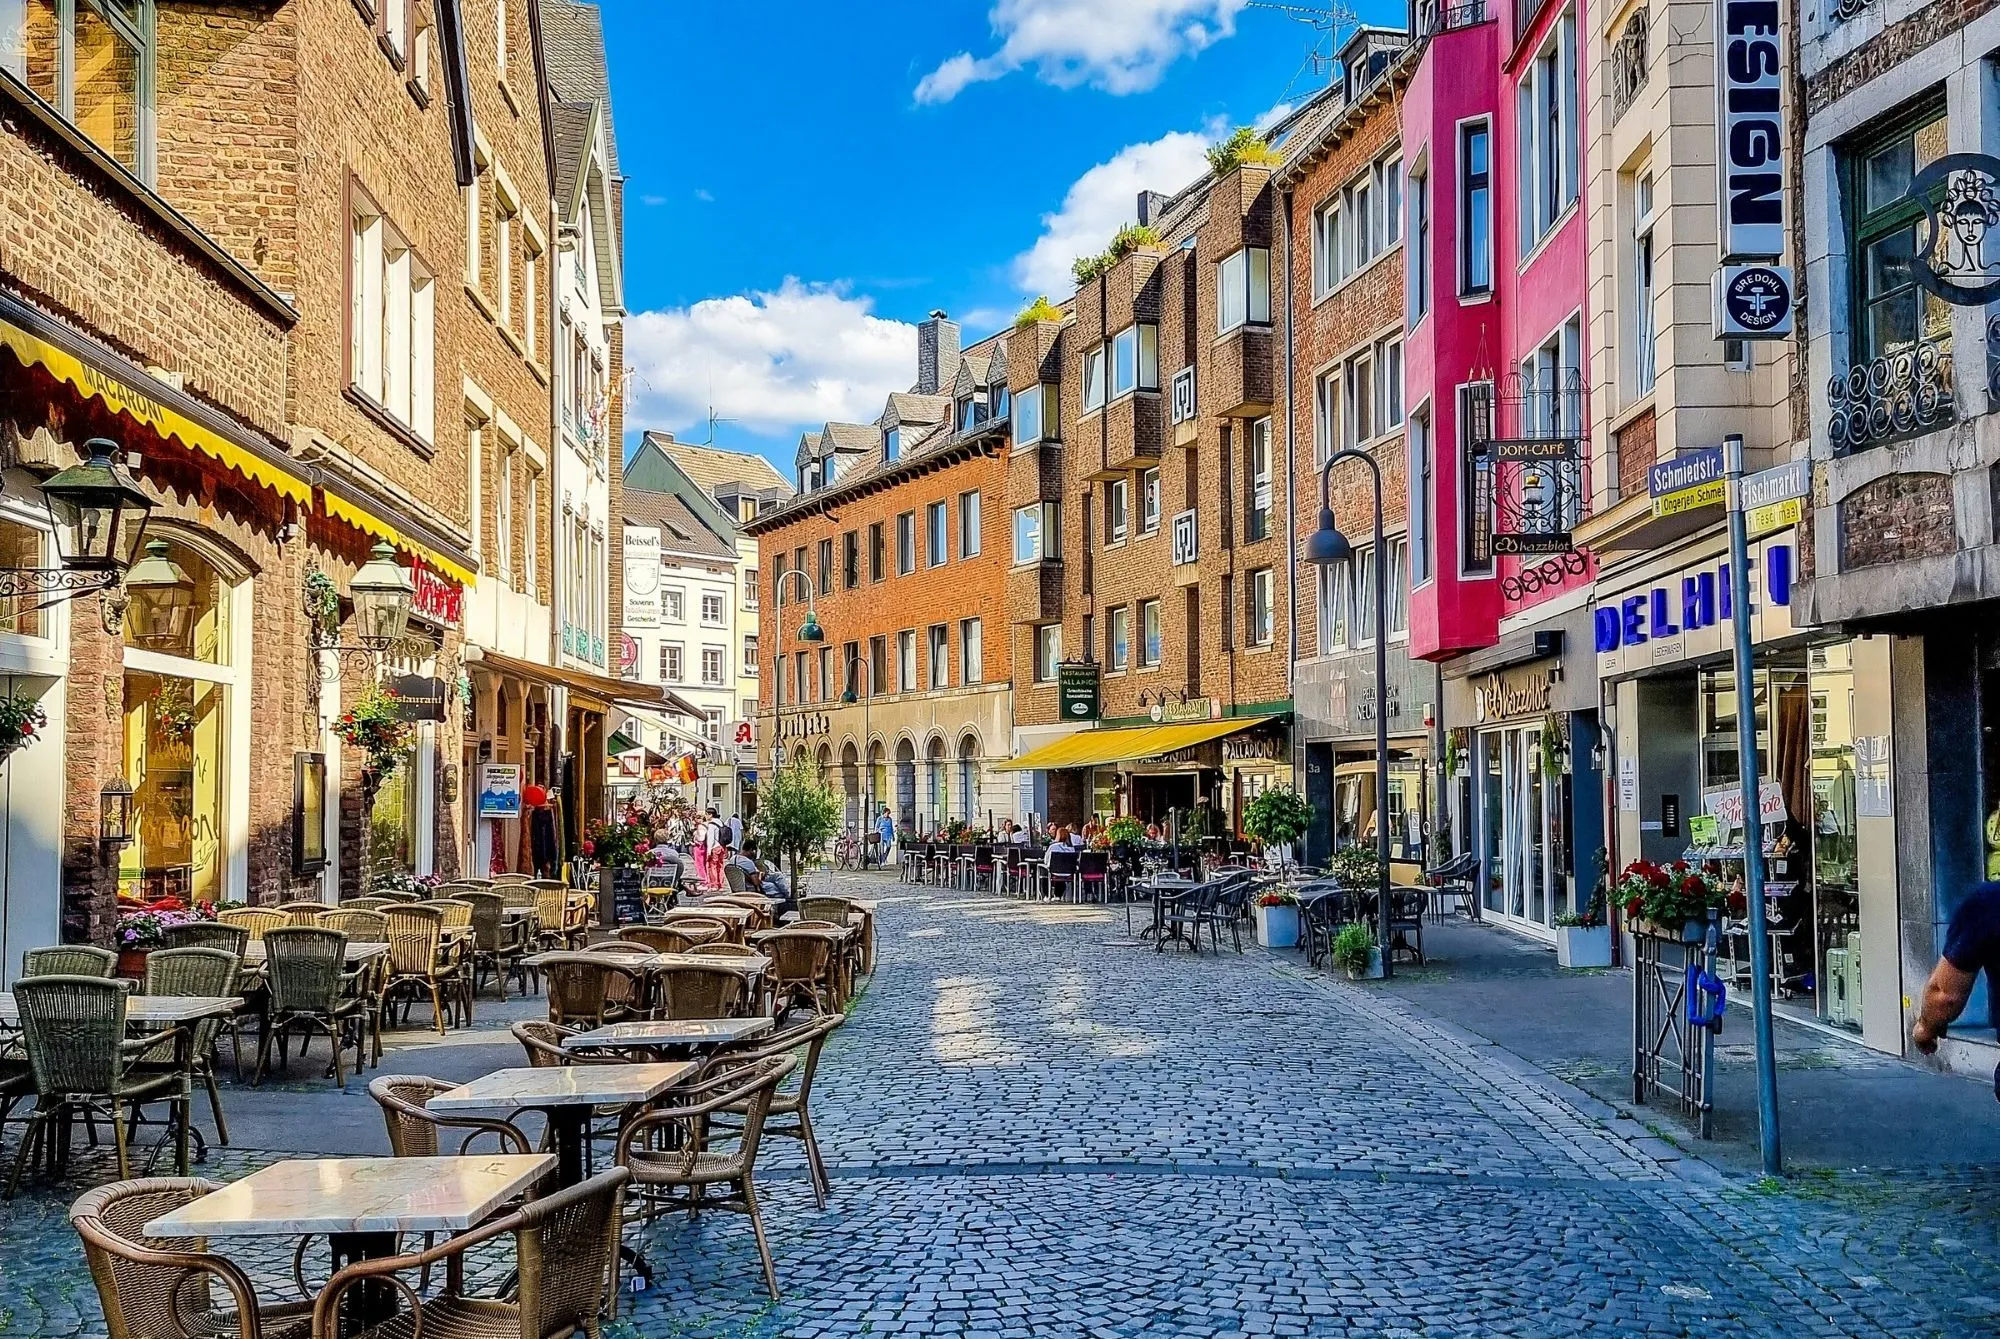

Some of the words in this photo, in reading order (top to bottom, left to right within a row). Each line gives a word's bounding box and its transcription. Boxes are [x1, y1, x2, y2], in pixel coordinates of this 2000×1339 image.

[1734, 274, 1781, 294] BREDOHL
[1739, 310, 1778, 327] DESIGN
[81, 363, 165, 425] MACARONI
[1497, 442, 1566, 457] DOM-CAFÉ
[1654, 454, 1721, 492] Schmiedstr.
[1741, 466, 1802, 507] Fischmarkt
[1663, 493, 1696, 512] Ongerjen
[624, 534, 660, 547] Beissel's
[629, 598, 655, 606] Souvenirs
[627, 615, 656, 623] Geschenke
[389, 694, 442, 704] estaurant
[1165, 700, 1207, 716] RESTAURANT
[1308, 763, 1321, 774] 3a
